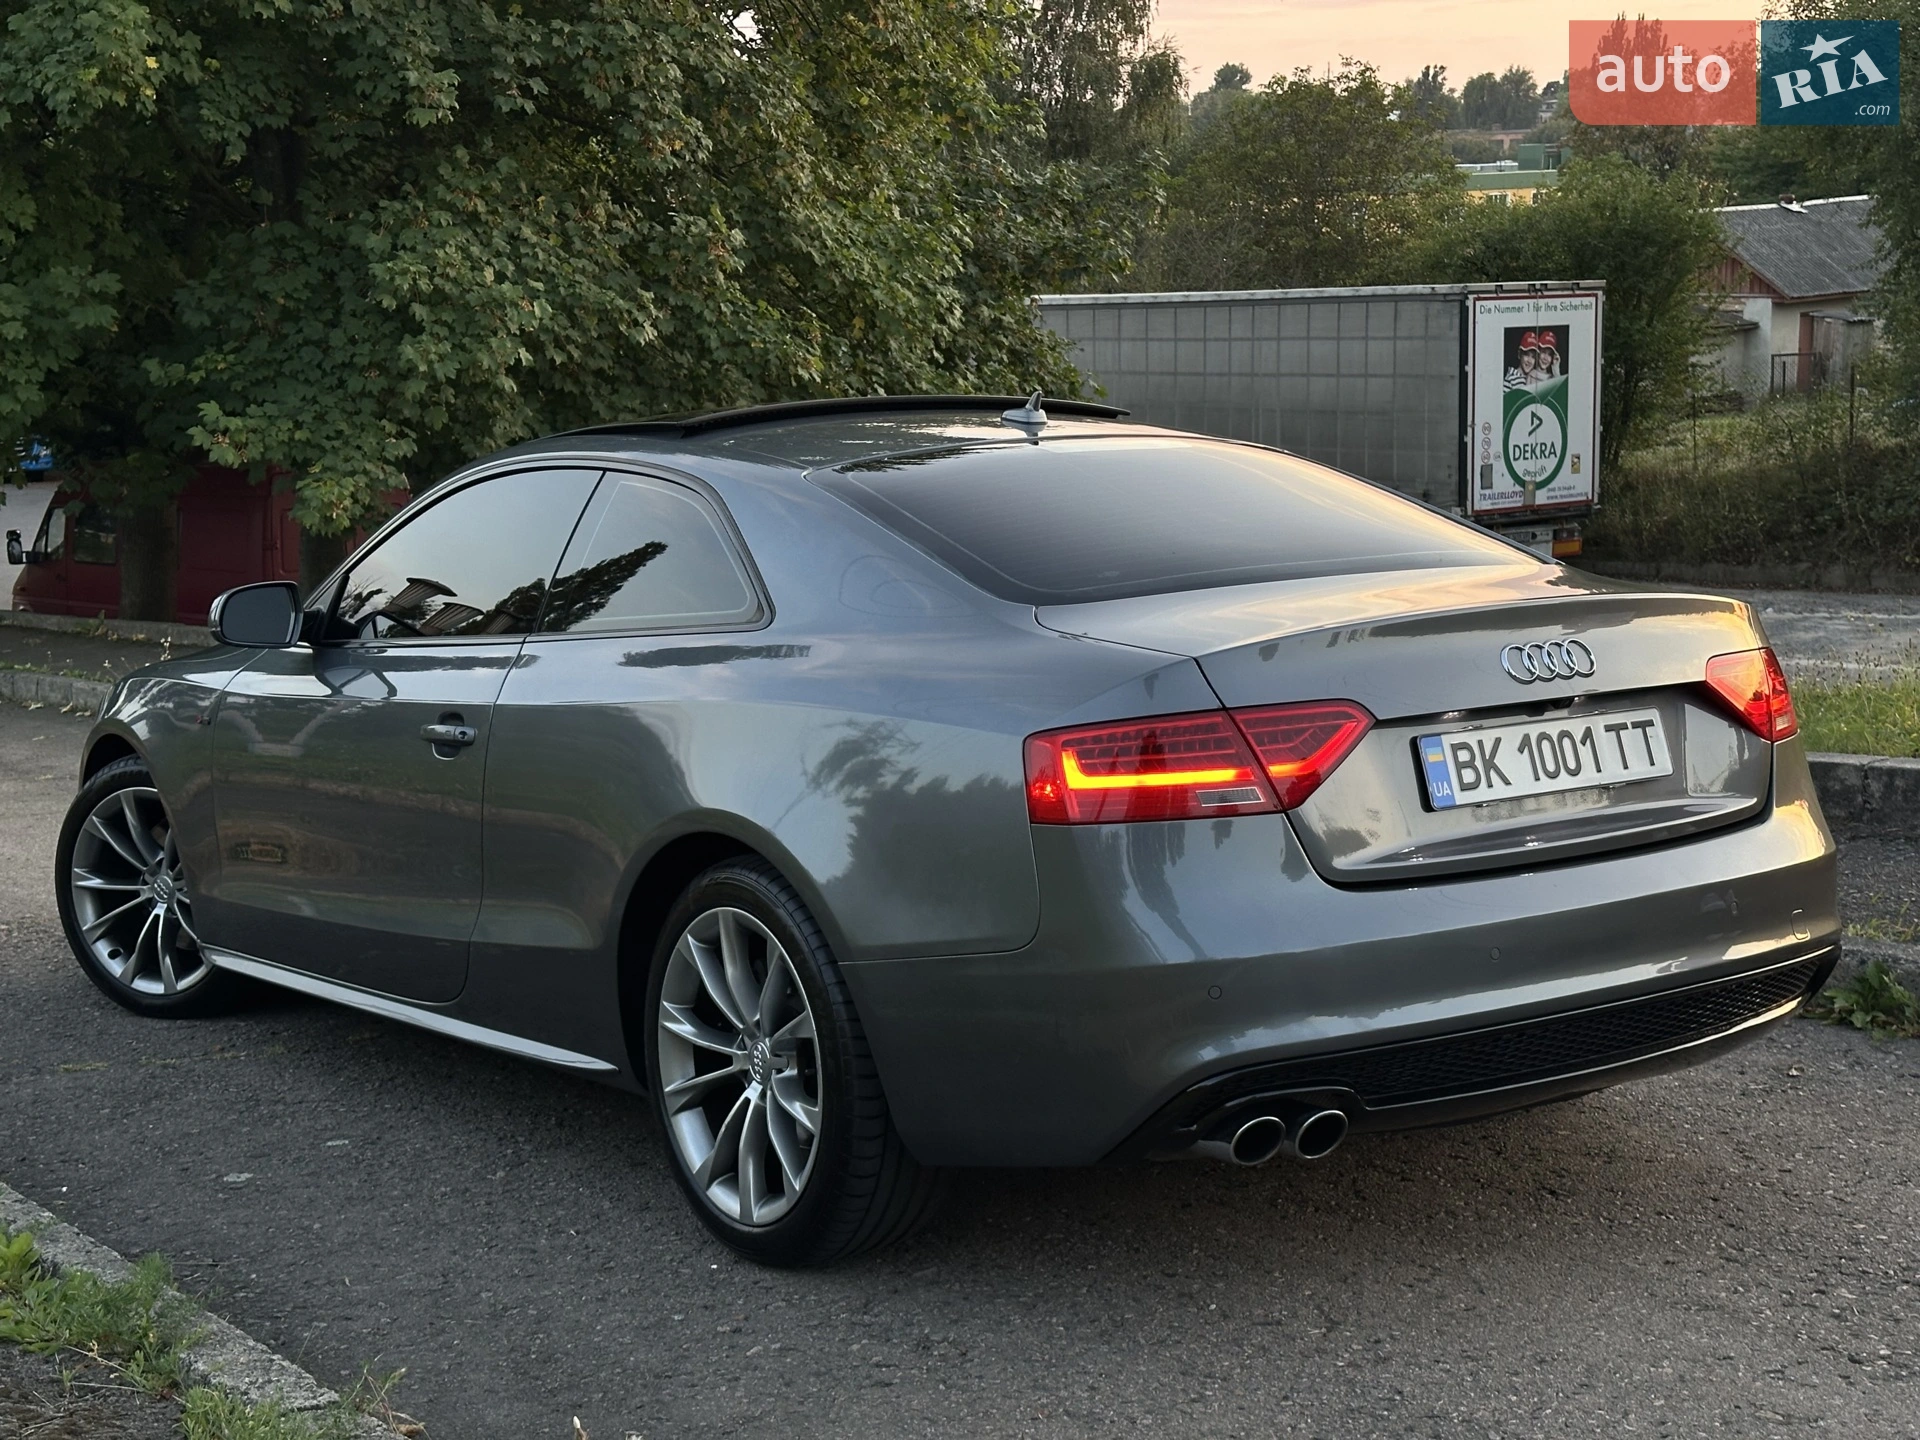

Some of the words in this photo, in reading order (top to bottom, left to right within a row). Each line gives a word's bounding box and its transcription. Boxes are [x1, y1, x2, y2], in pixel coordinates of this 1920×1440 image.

[1480, 304, 1492, 314] Die
[1494, 304, 1524, 314] Nummer
[1533, 302, 1543, 313] für
[1544, 301, 1558, 312] Ihre
[1560, 301, 1593, 312] Sicherheit
[1512, 442, 1557, 461] DEKRA
[1522, 464, 1547, 479] geprüft
[1479, 490, 1524, 501] TRAILERLLOYD
[1450, 736, 1512, 791] BK
[1517, 725, 1602, 781] 1001
[1603, 718, 1655, 770] TT
[1433, 782, 1452, 797] UA
